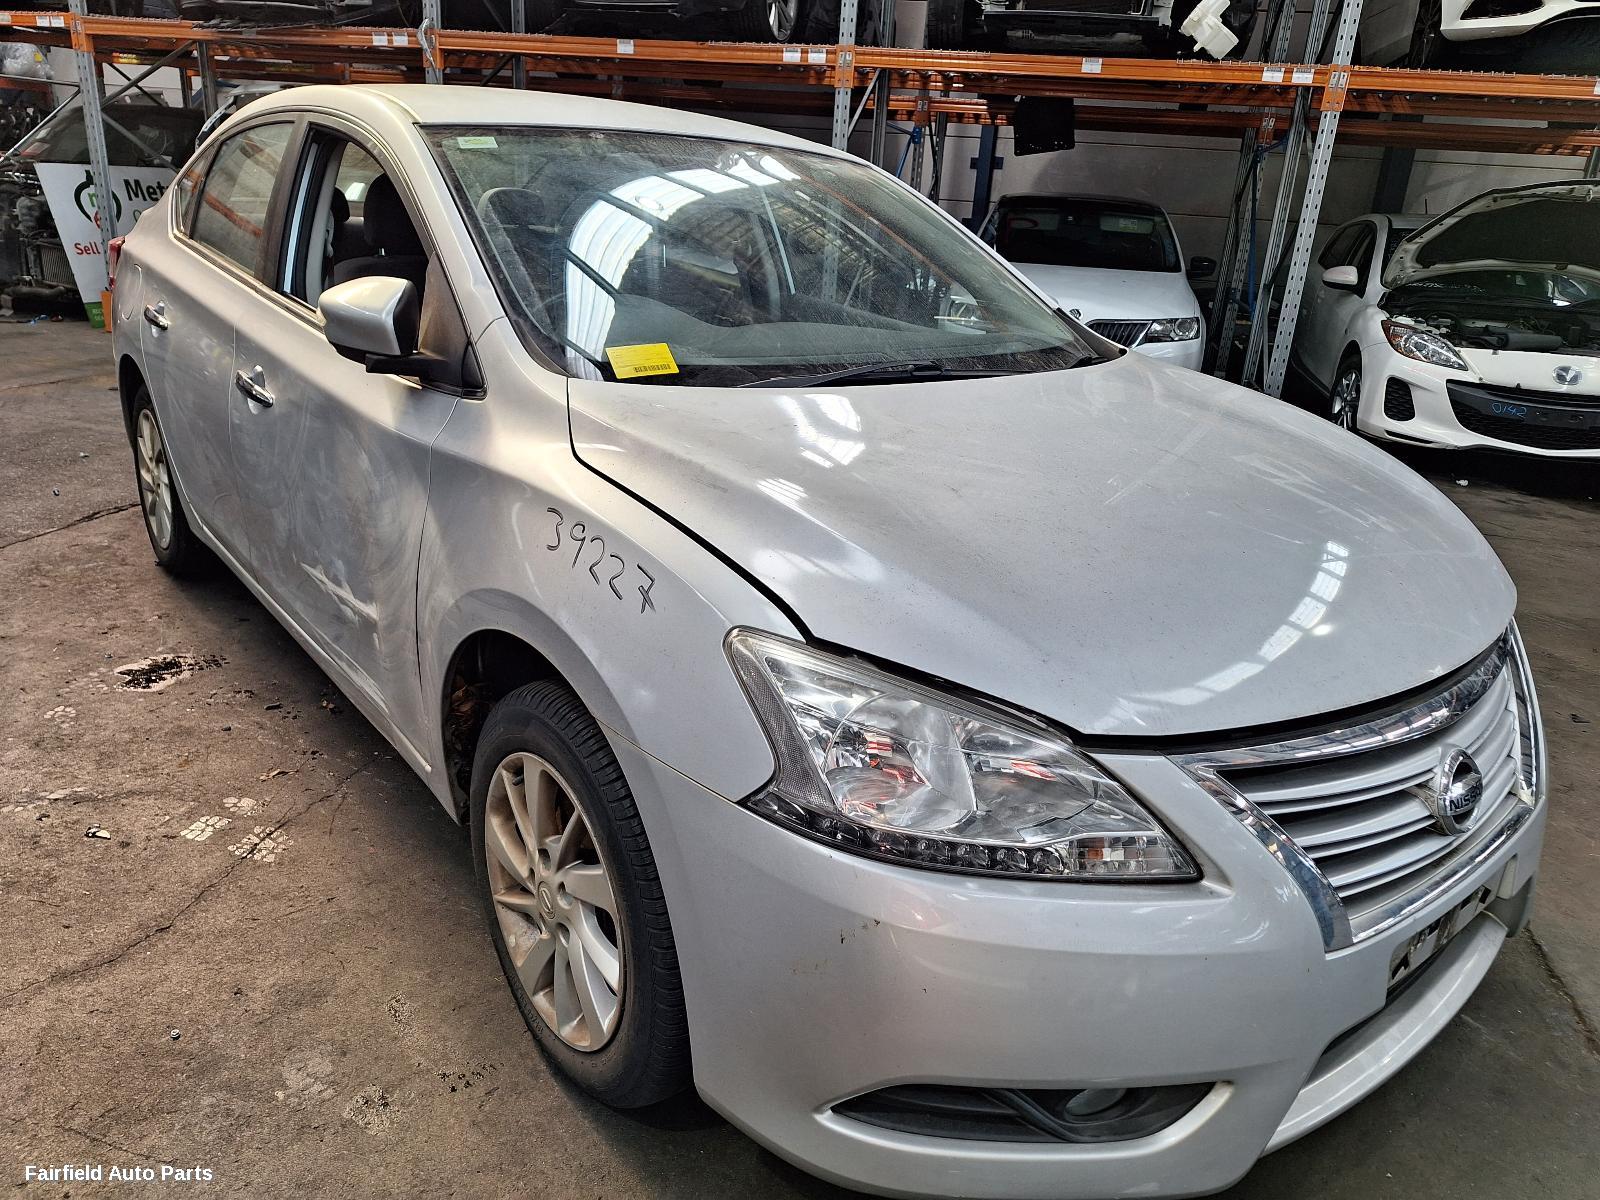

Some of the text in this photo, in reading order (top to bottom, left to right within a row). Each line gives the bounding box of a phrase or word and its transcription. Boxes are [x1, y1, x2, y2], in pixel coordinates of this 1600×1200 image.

[123, 179, 168, 201] Met
[74, 242, 101, 256] Sell
[1491, 402, 1527, 418] 0142
[546, 507, 656, 614] 39227
[1449, 787, 1481, 811] NISS
